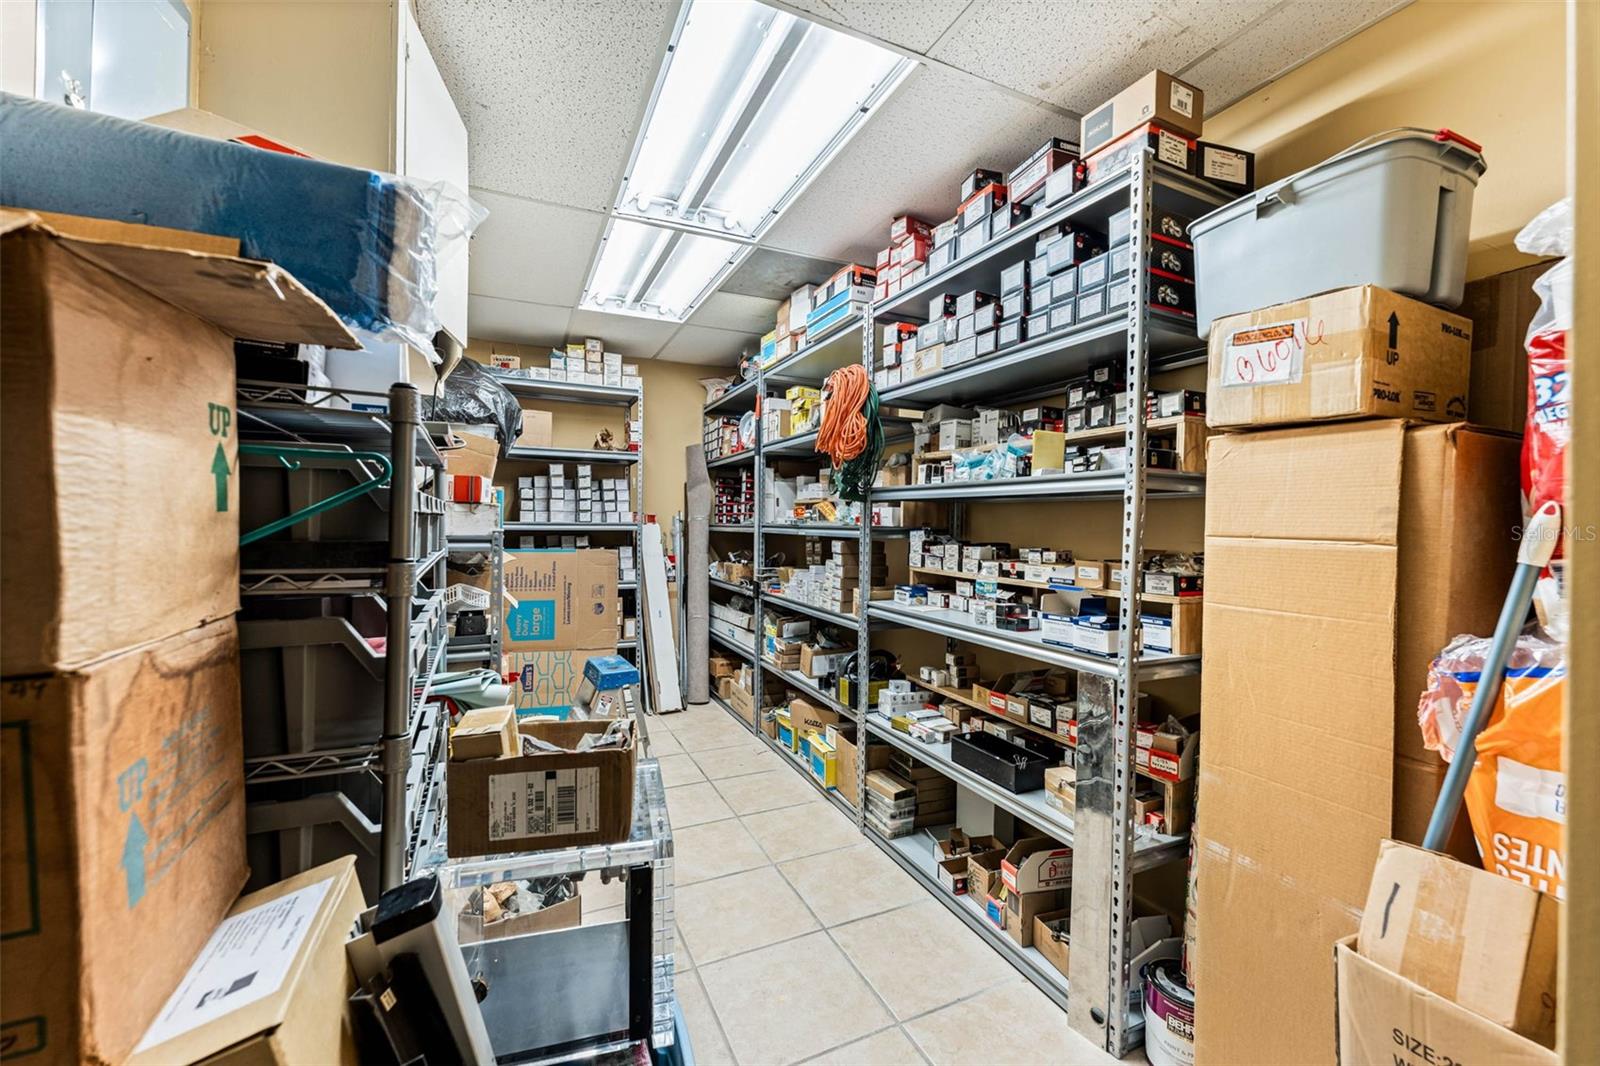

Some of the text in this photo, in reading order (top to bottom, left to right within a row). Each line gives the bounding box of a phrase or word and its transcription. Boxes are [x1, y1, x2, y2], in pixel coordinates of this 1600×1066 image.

[1386, 350, 1399, 365] UP
[208, 402, 231, 438] UP
[530, 608, 542, 636] large
[117, 757, 149, 813] UP
[1392, 1027, 1462, 1066] SIZE:2
